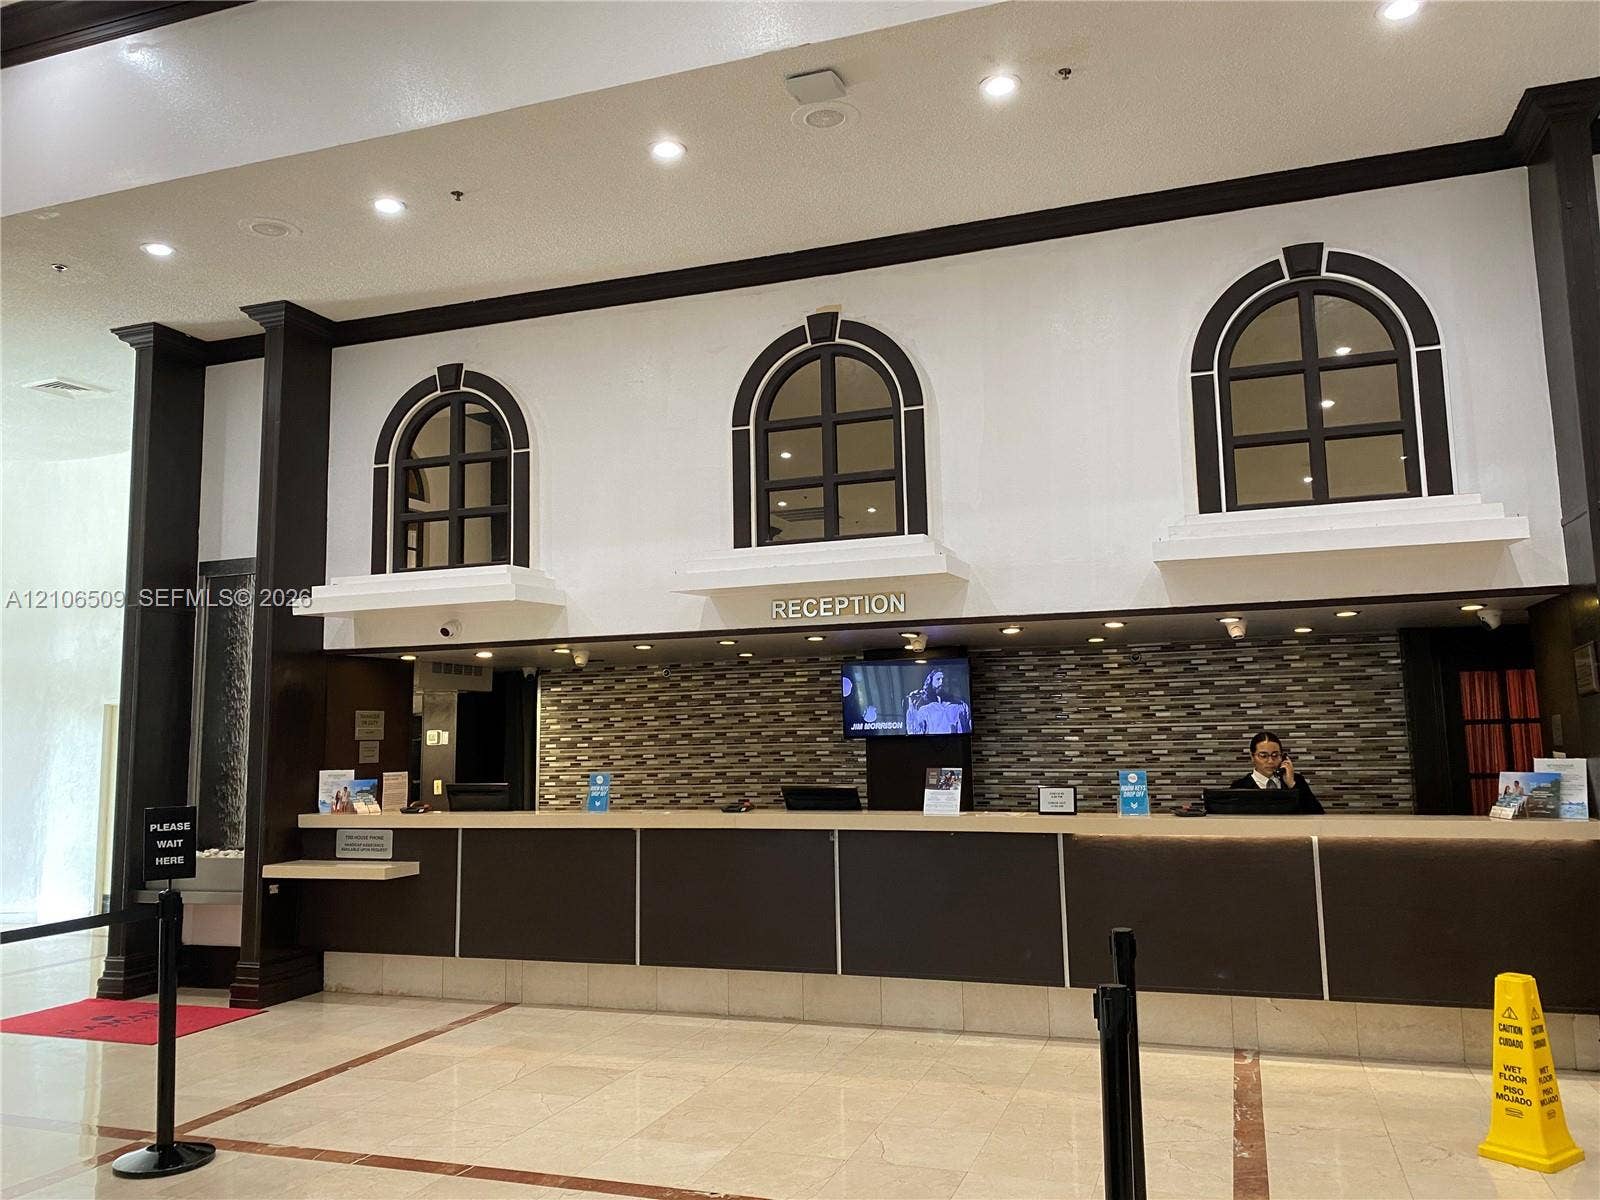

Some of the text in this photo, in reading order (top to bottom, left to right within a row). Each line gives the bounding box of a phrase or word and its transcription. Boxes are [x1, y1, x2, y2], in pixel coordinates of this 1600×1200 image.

[771, 592, 906, 619] RECEPTION
[850, 721, 904, 731] JIM MORRISON
[149, 822, 191, 832] PLEASE
[156, 839, 184, 848] WAIT
[155, 856, 185, 866] HERE
[1498, 1022, 1523, 1036] CAUTION
[1498, 1036, 1524, 1050] CUIDADO
[1503, 1064, 1522, 1074] WET
[1539, 1065, 1550, 1075] WET
[1498, 1072, 1528, 1085] FLOOR
[1538, 1074, 1554, 1085] FLOOR
[1503, 1085, 1524, 1096] PISO
[1495, 1092, 1533, 1107] MOJADO
[1540, 1094, 1560, 1107] MOJADO
